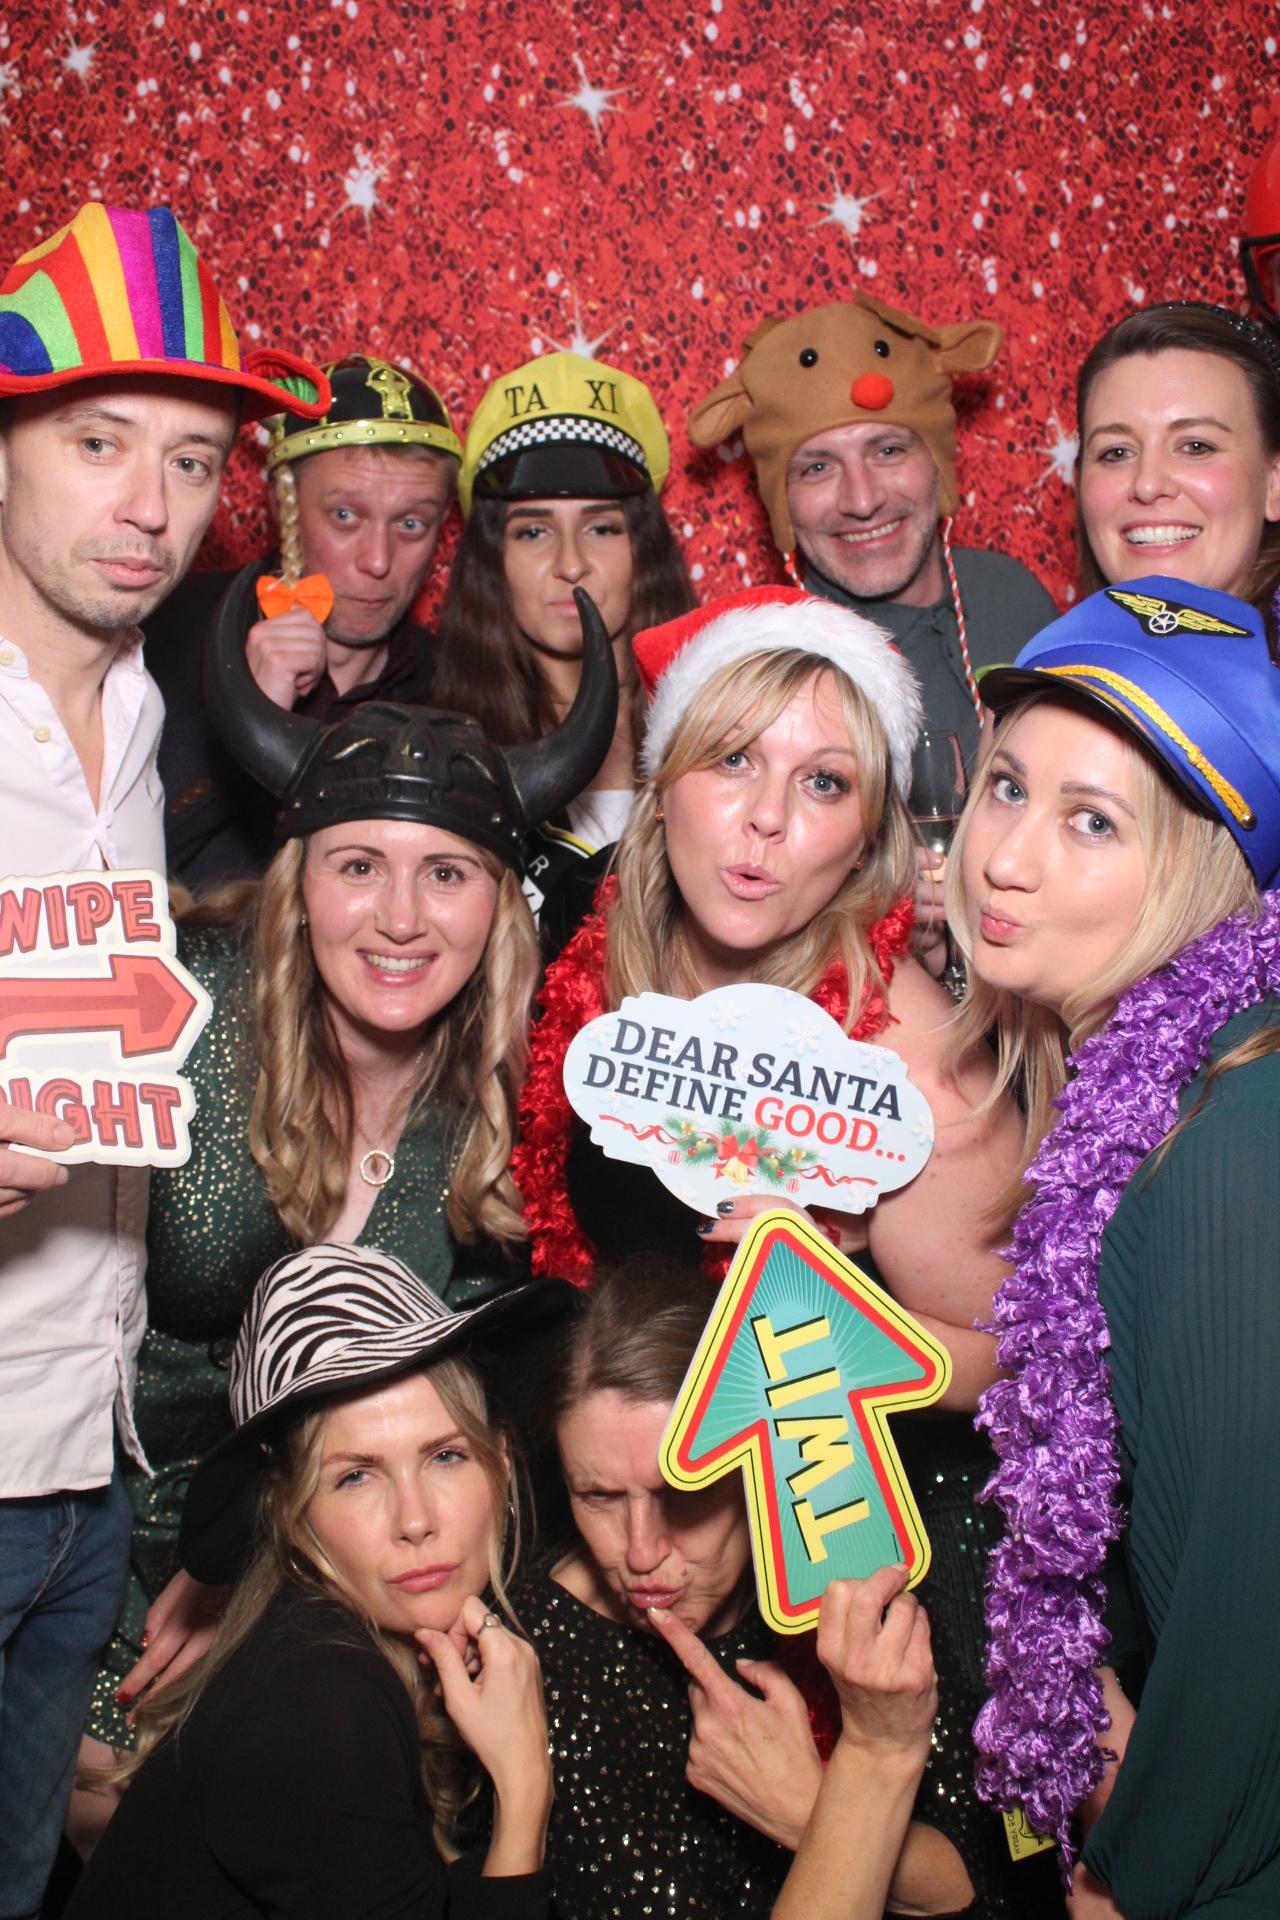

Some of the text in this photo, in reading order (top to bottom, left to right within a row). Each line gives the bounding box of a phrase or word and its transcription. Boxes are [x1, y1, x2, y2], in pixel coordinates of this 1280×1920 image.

[0, 880, 161, 957] WIPE
[0, 1077, 182, 1150] IGHT
[583, 1054, 906, 1162] DEFINE GOOD...
[610, 1018, 902, 1121] DEAR SANTA
[750, 1313, 871, 1565] TWIT
